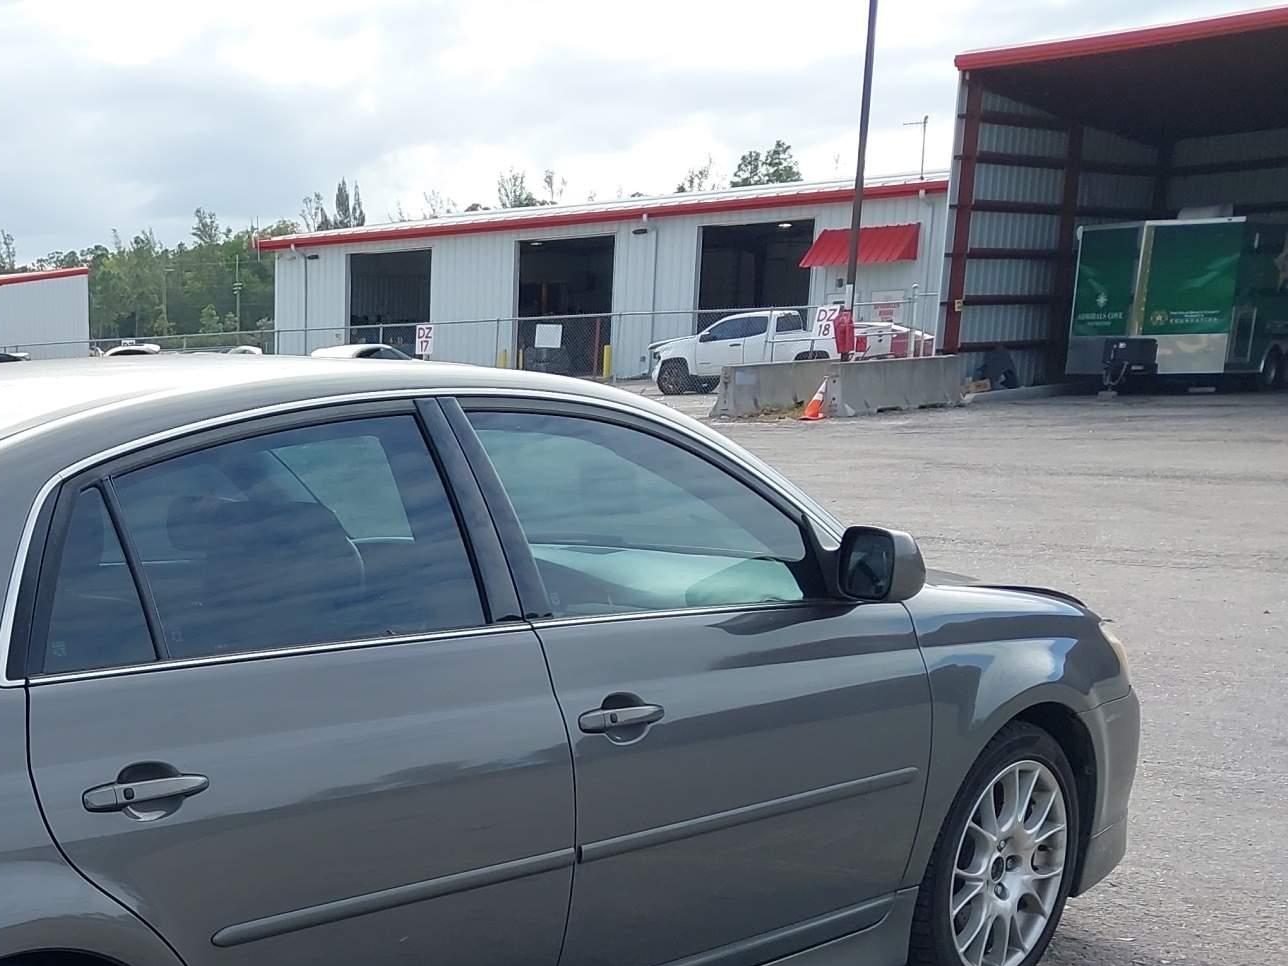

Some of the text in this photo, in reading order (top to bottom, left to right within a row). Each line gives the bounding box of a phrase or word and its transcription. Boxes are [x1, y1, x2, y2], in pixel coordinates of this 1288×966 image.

[817, 308, 838, 322] DZ
[418, 327, 432, 339] DZ
[818, 323, 831, 336] 18
[420, 340, 429, 352] 17
